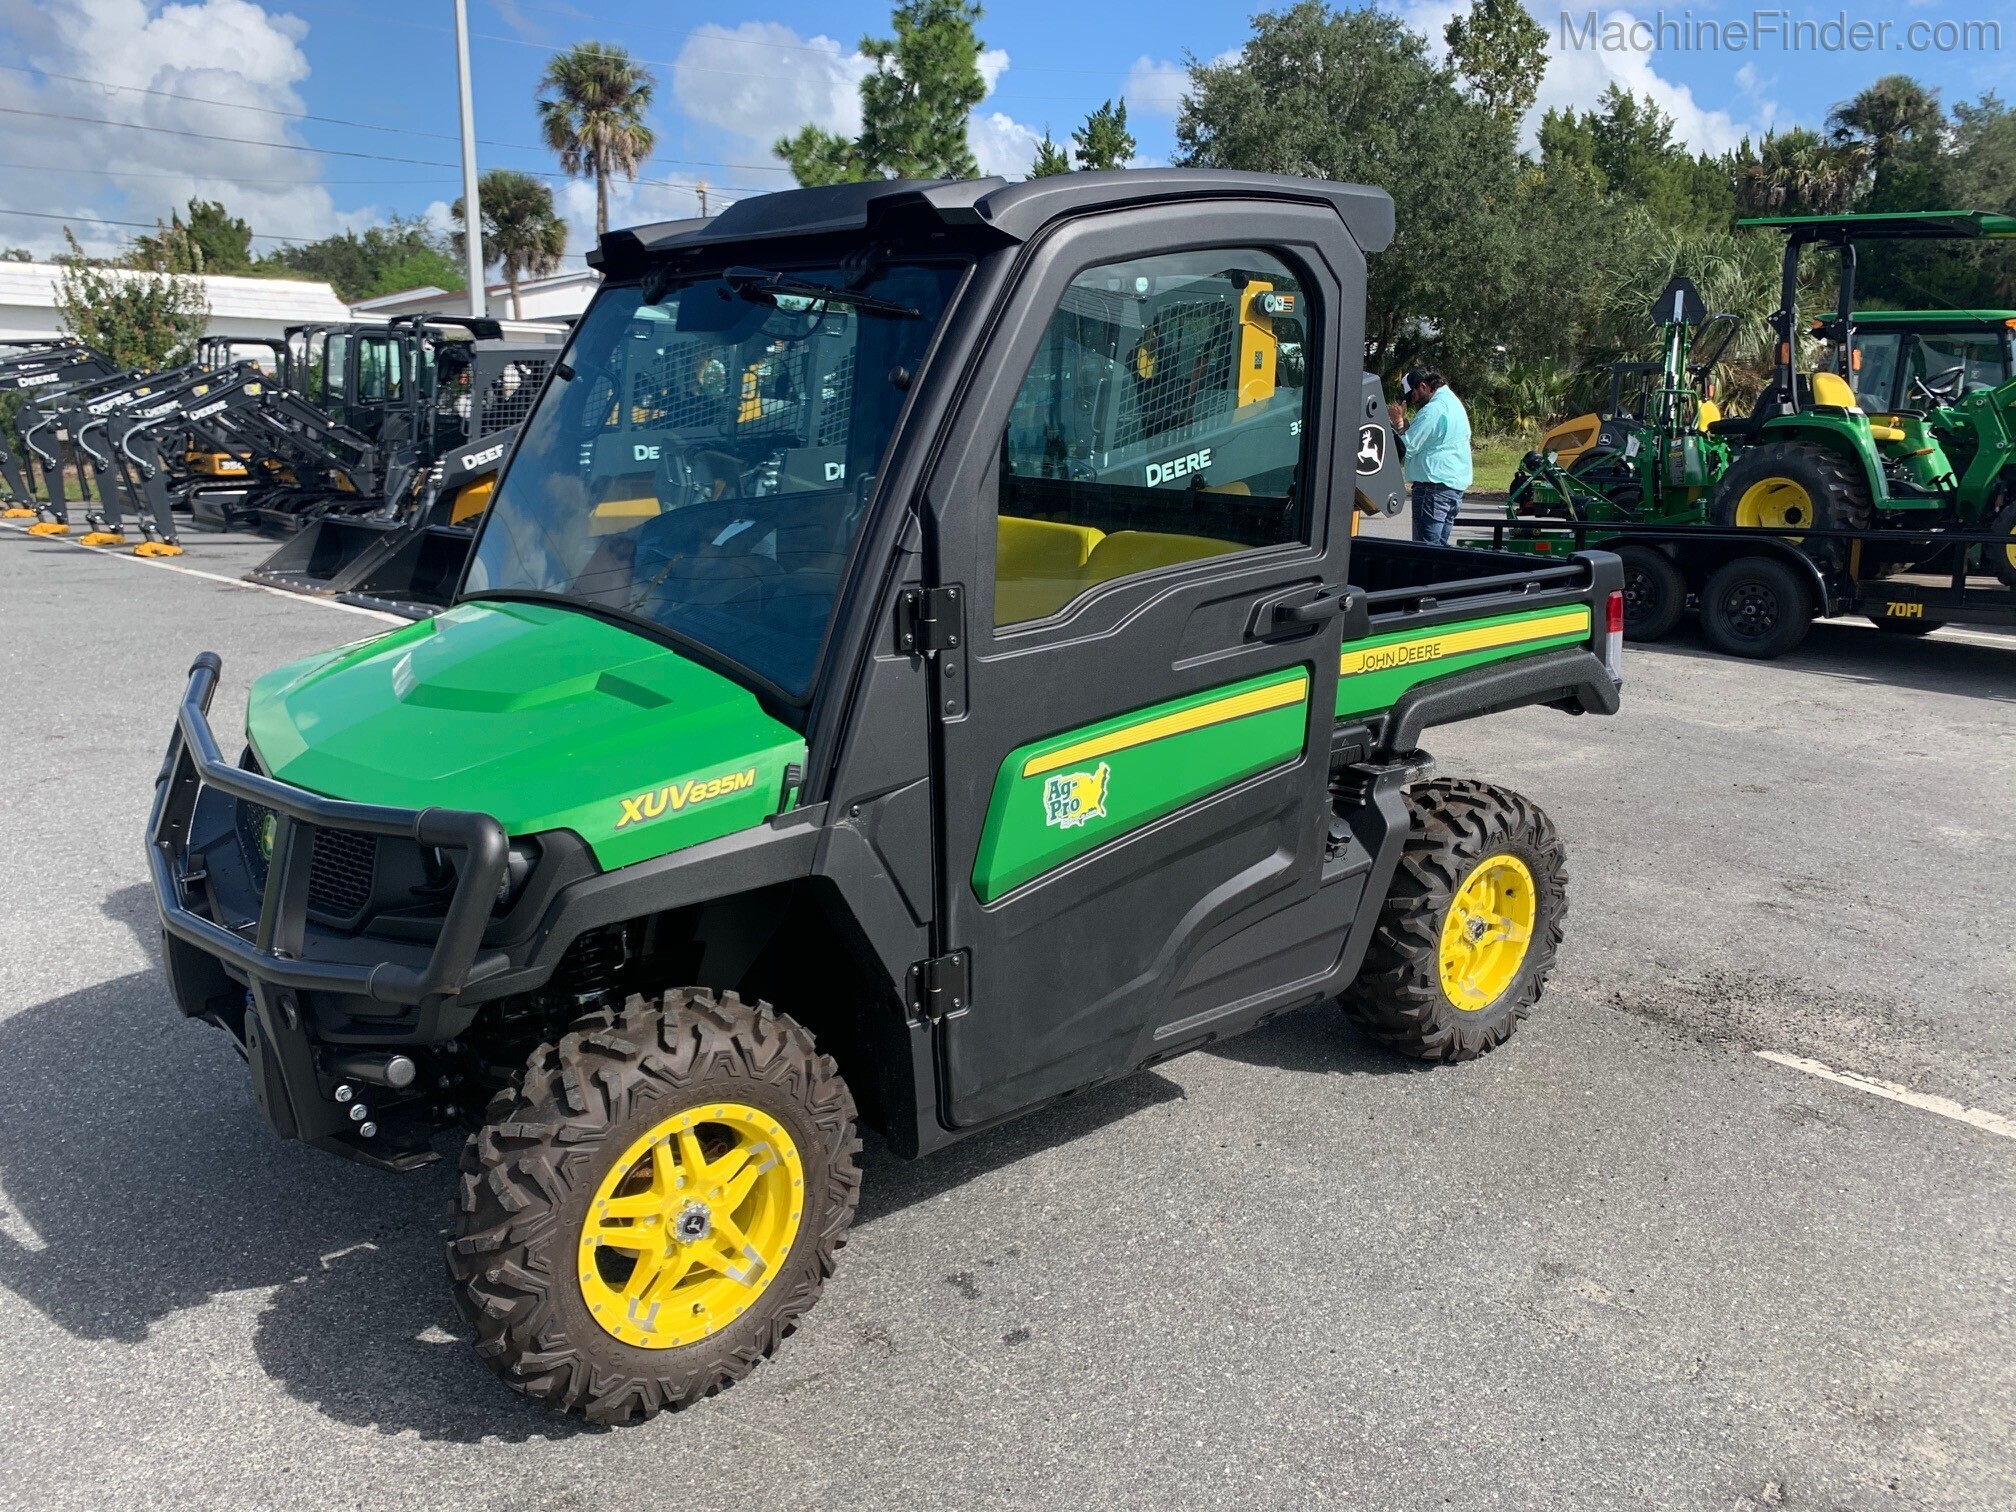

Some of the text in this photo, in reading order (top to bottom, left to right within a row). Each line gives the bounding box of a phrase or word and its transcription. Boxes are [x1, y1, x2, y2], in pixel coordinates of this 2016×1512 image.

[17, 373, 60, 388] DEERE
[189, 400, 228, 420] DEERE
[1145, 447, 1212, 488] DEERE
[1886, 602, 1924, 618] 70PI
[1357, 642, 1441, 672] JOHN DEERE
[614, 767, 757, 831] XUV835M
[1048, 780, 1078, 802] Ag-
[1049, 798, 1081, 821] Pro
